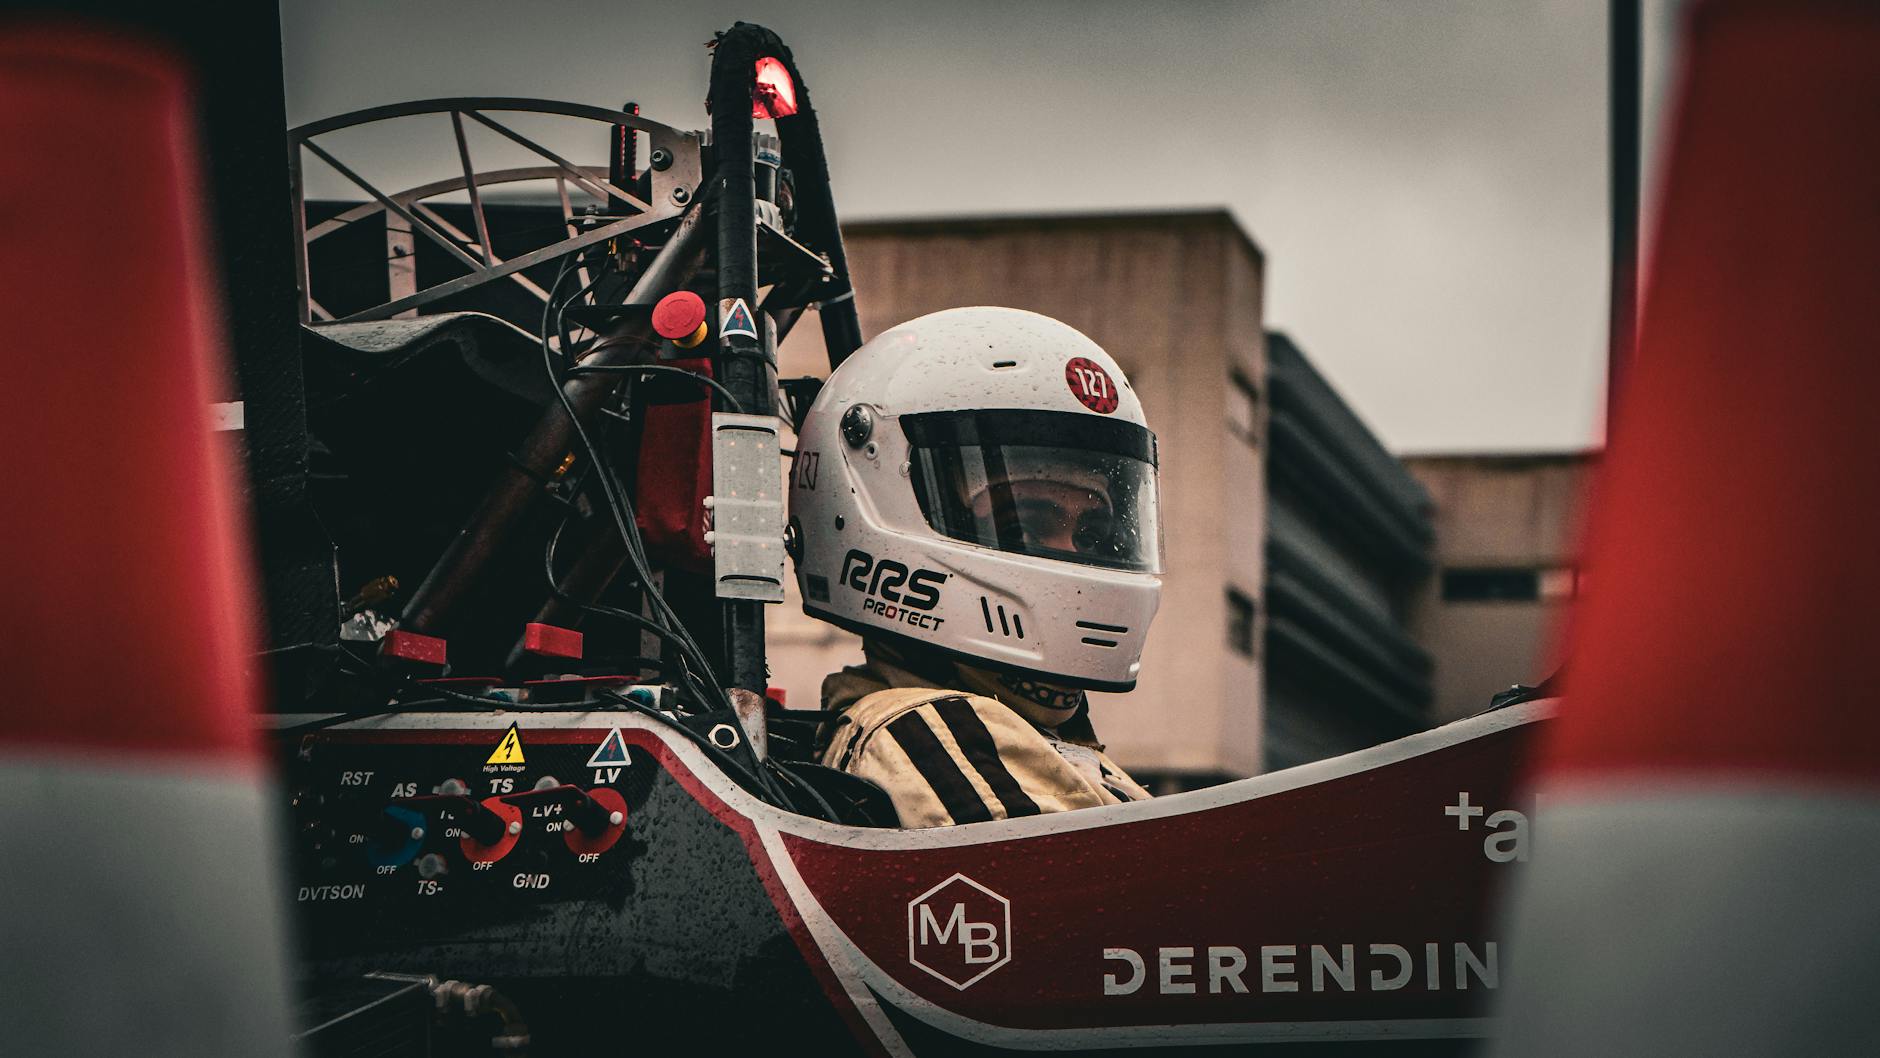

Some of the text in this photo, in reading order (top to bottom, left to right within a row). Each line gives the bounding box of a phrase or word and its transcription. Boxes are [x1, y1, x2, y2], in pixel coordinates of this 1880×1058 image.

[1074, 367, 1108, 399] 127
[839, 548, 948, 611] RRS
[863, 598, 945, 631] PROTECT
[483, 764, 526, 774] High Voltage
[594, 767, 621, 784] LV
[341, 771, 374, 786] RST
[490, 778, 514, 794] TS
[391, 782, 417, 798] AS
[532, 803, 563, 818] LV+
[445, 828, 461, 838] ON
[546, 822, 562, 833] ON
[349, 834, 364, 844] ON
[472, 861, 493, 872] OFF
[578, 853, 600, 864] OFF
[376, 865, 397, 875] OFF
[417, 880, 443, 896] TS-
[512, 873, 550, 889] GND
[298, 884, 365, 902] DVTSON
[919, 903, 1000, 964] MB
